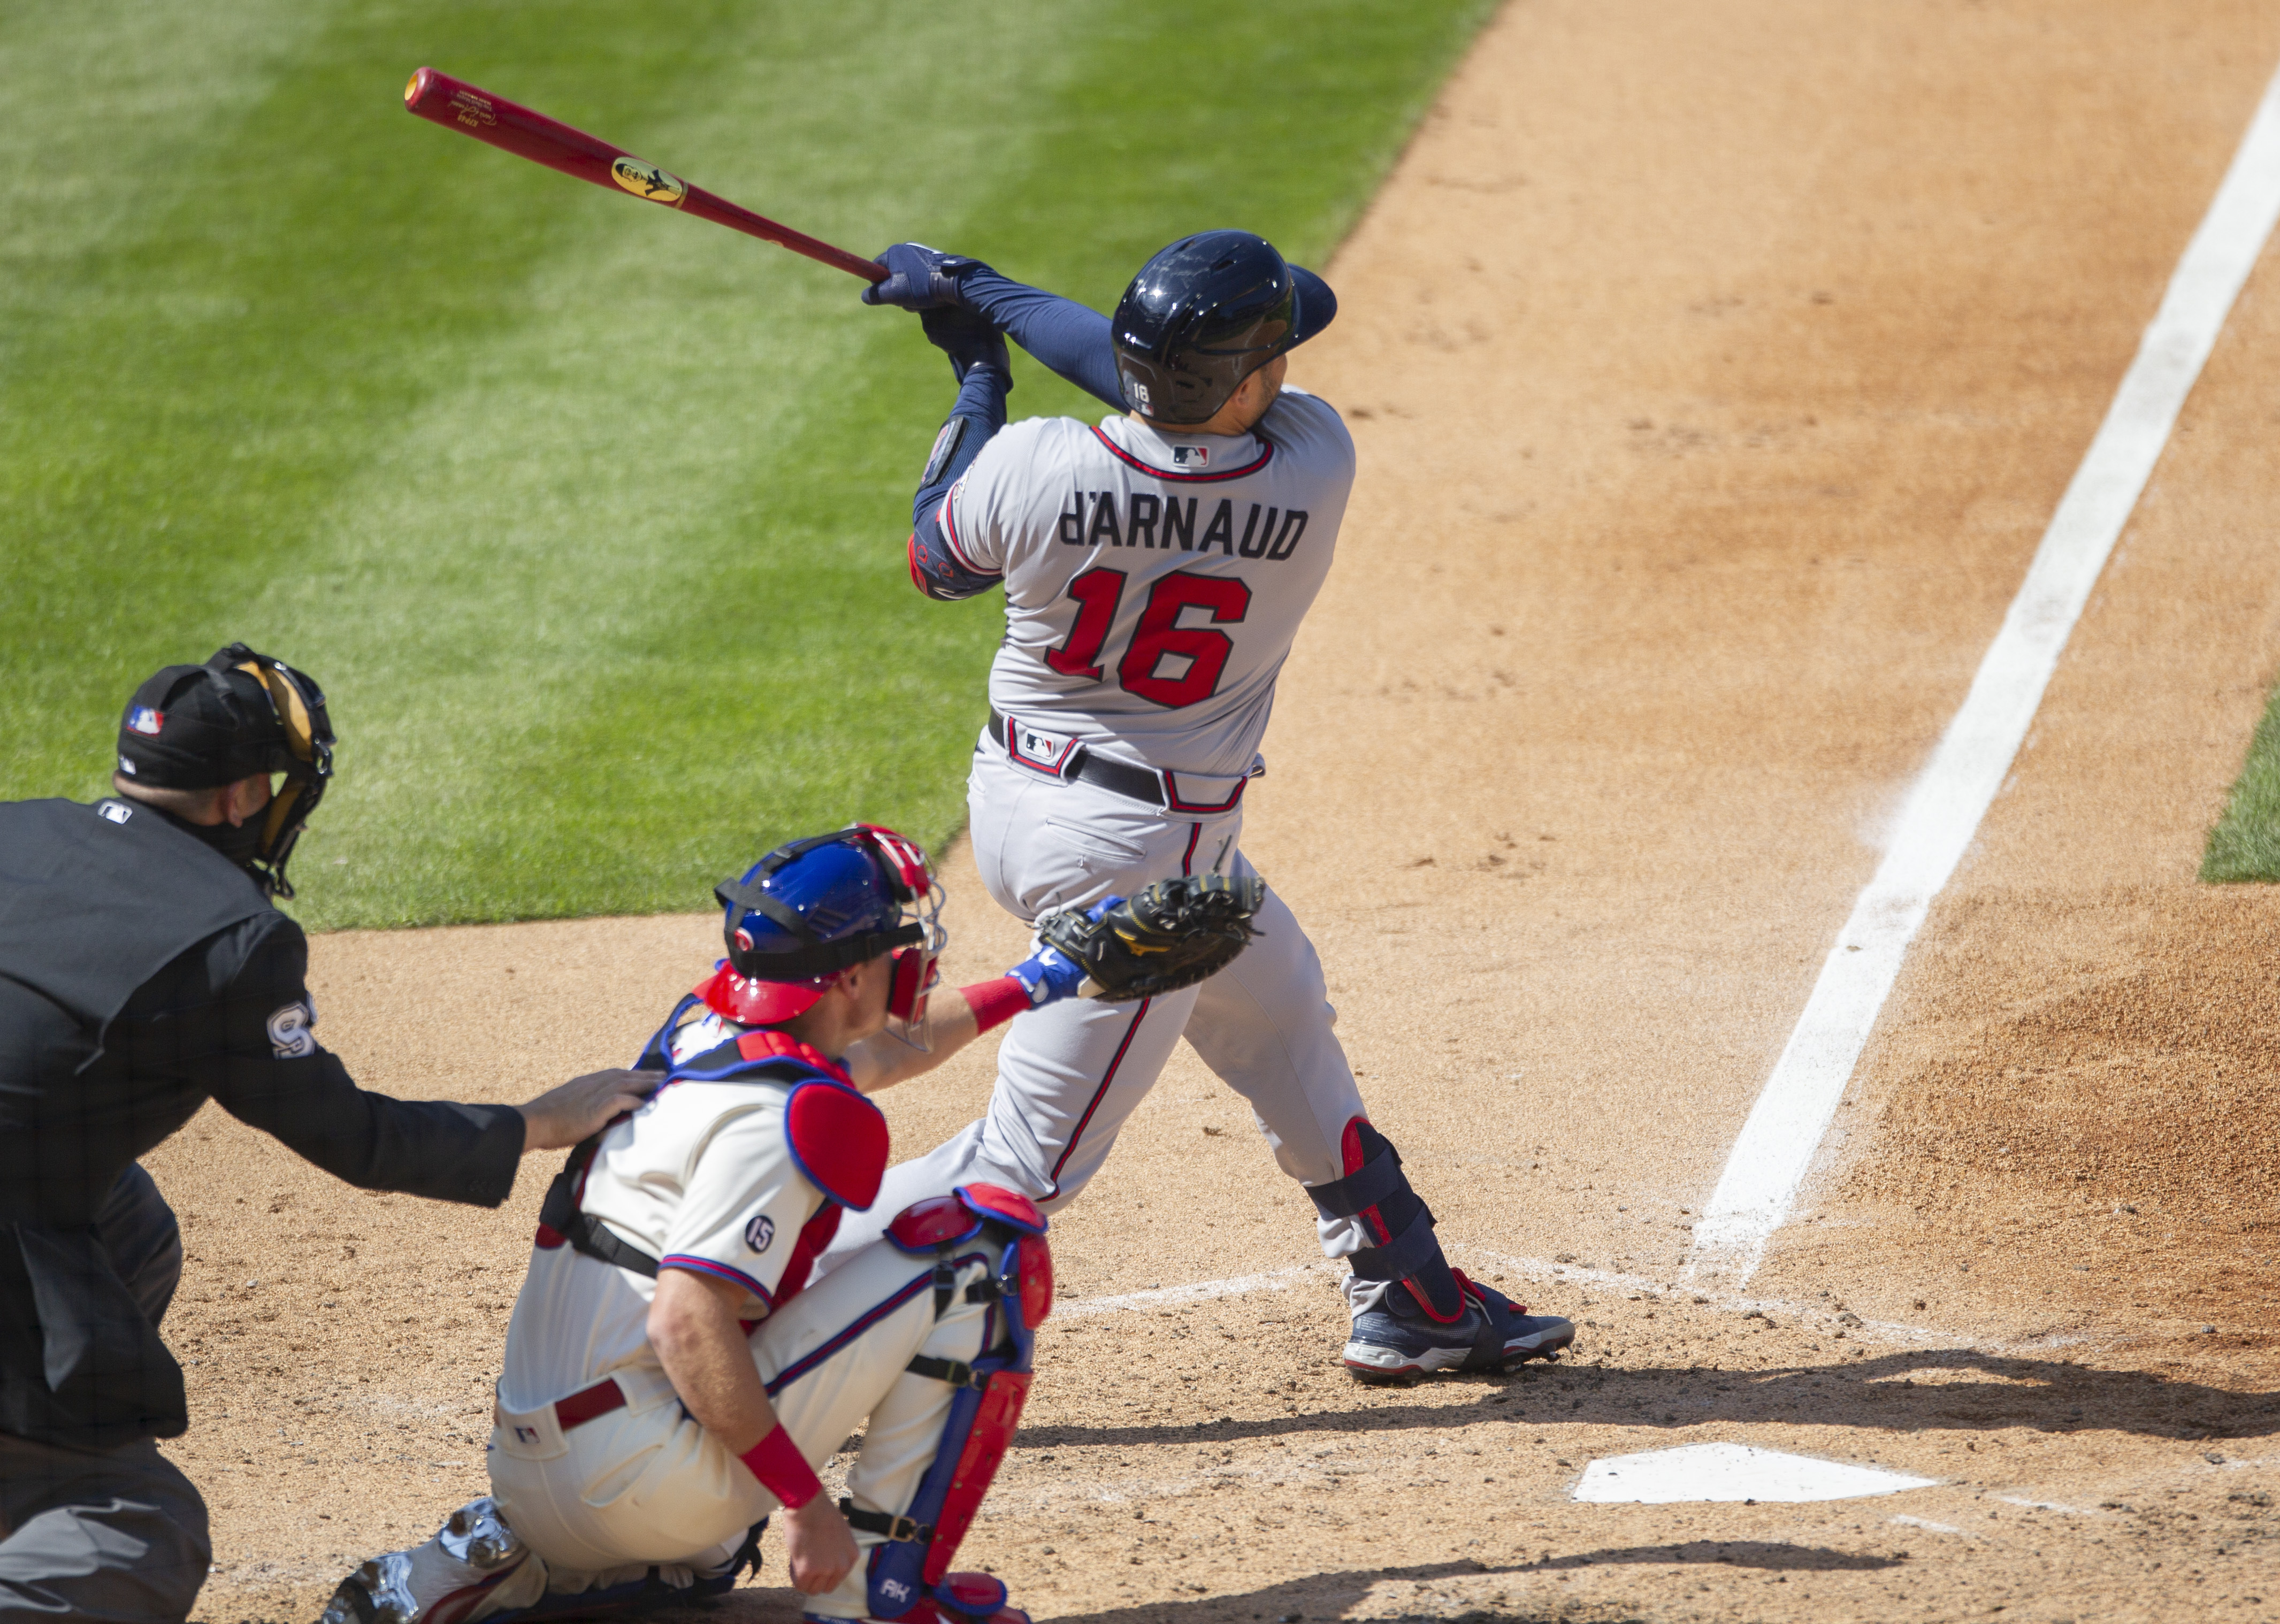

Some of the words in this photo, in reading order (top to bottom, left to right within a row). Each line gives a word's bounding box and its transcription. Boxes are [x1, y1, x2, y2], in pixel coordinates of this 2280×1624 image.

[1058, 491, 1309, 561] d'ARNAUD
[1043, 566, 1252, 709] 16
[747, 1217, 775, 1251] 15
